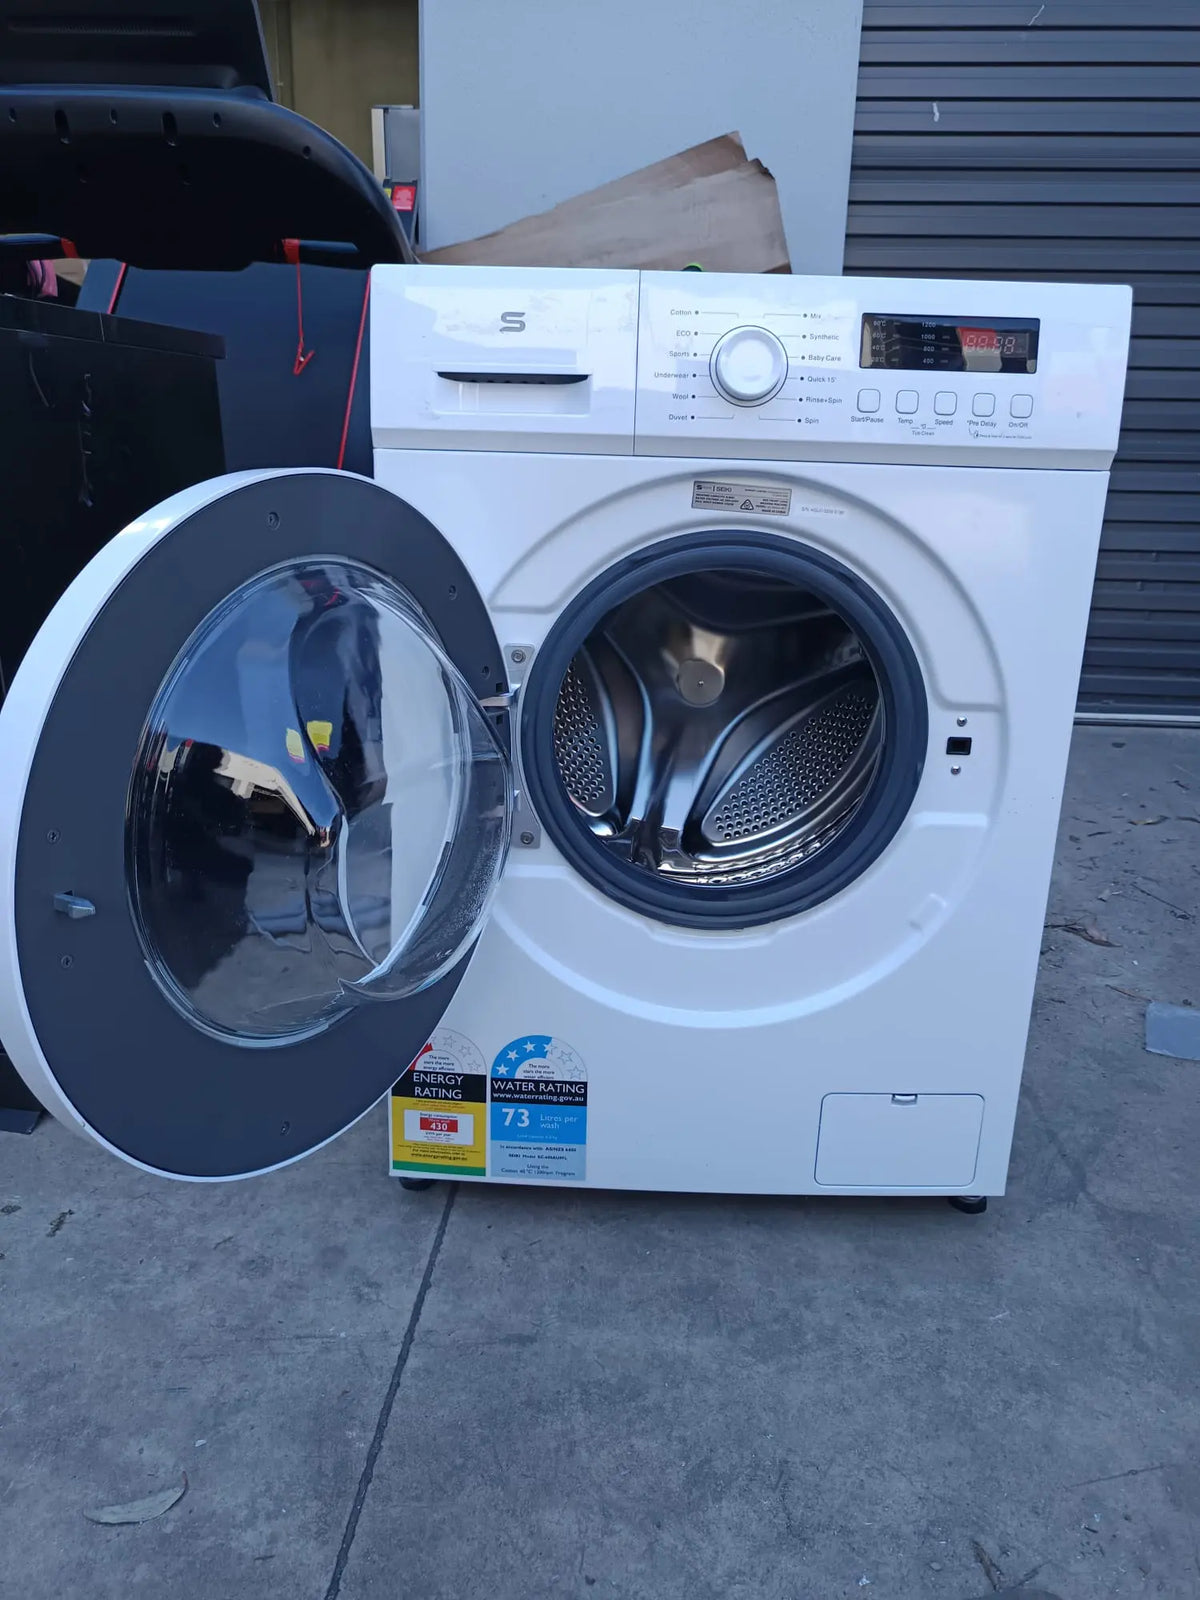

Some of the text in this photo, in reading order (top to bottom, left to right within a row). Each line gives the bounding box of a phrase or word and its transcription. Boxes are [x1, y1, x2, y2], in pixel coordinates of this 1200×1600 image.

[810, 312, 822, 320] Mix
[499, 311, 526, 333] S
[809, 333, 840, 341] Synthetic
[669, 350, 690, 358] Sports
[808, 354, 825, 362] Baby
[654, 371, 689, 379] Underwear
[807, 375, 826, 383] Quick
[805, 395, 843, 405] Rinse+Spin
[668, 413, 688, 421] Duvet
[804, 417, 820, 425] Spin
[850, 415, 885, 424] Start/Pause
[897, 417, 914, 425] Temp
[934, 418, 954, 426] Speed
[980, 420, 998, 428] Delay
[413, 1072, 464, 1085] ENERGY
[492, 1080, 585, 1094] WATER RATING
[414, 1087, 462, 1099] RATING
[492, 1092, 584, 1103] www.waterrating.gov.au
[501, 1107, 530, 1128] 73
[540, 1113, 578, 1124] Litres per
[430, 1122, 448, 1131] 430
